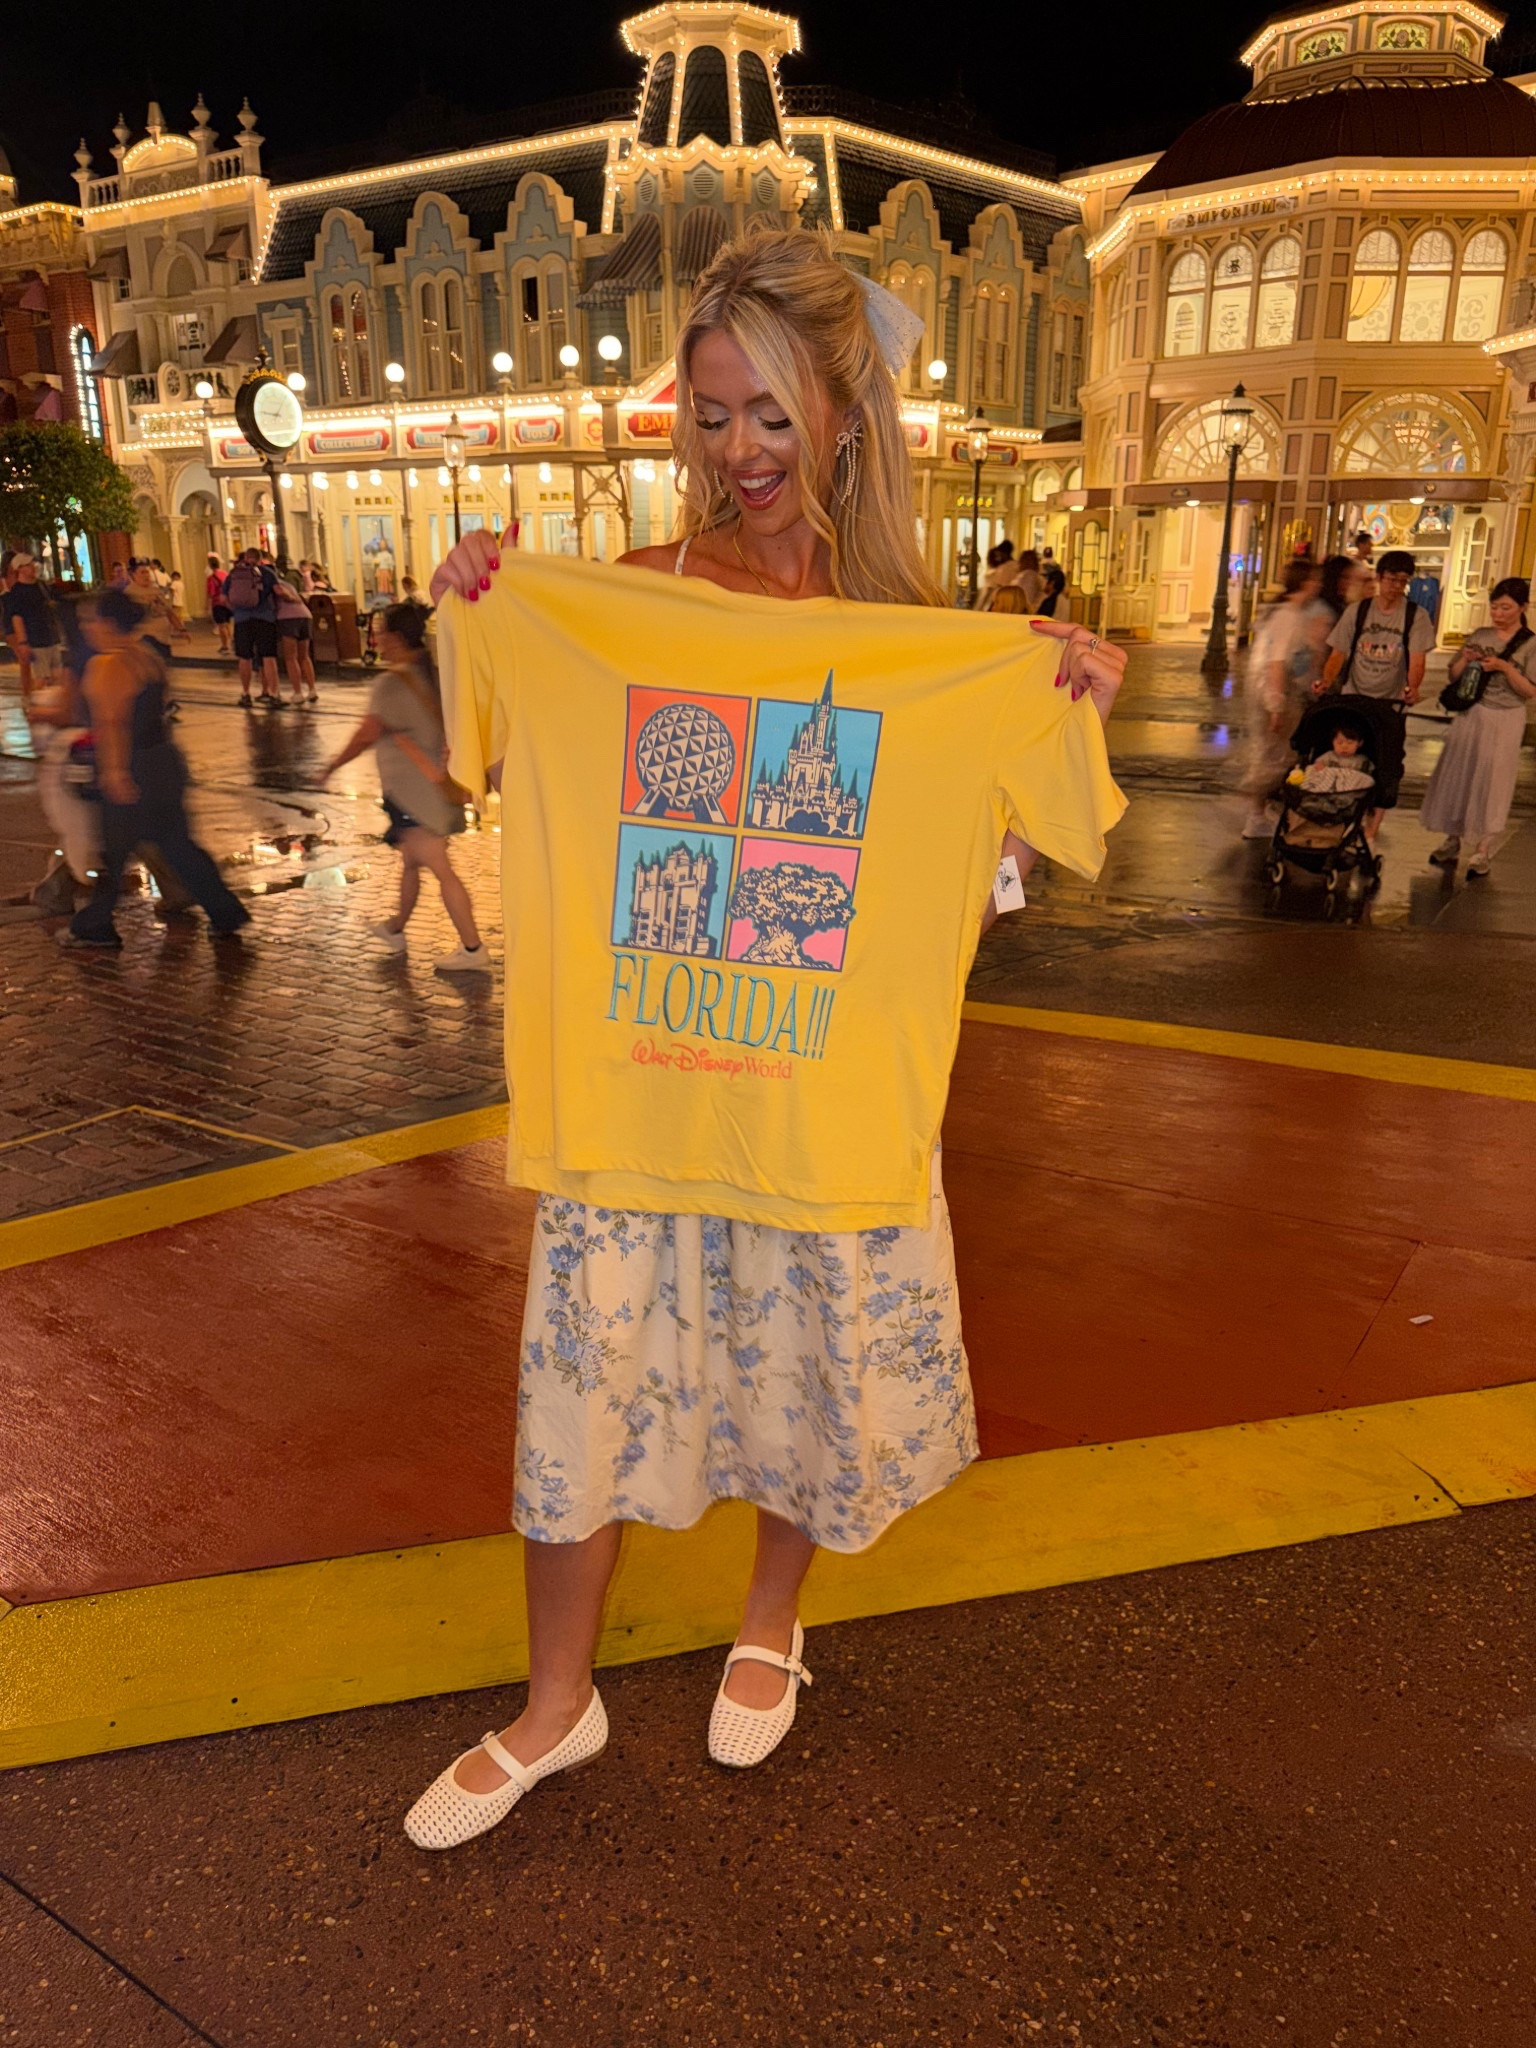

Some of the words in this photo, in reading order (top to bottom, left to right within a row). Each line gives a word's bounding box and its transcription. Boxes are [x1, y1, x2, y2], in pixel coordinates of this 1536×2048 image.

[1185, 198, 1276, 228] EMPORIUM
[320, 438, 377, 449] COLLECTIBLES
[526, 429, 550, 439] TOYS
[604, 952, 836, 1060] FLORIDA!!!
[631, 1038, 673, 1071] Walt
[671, 1043, 744, 1080] Disney
[744, 1056, 793, 1079] World
